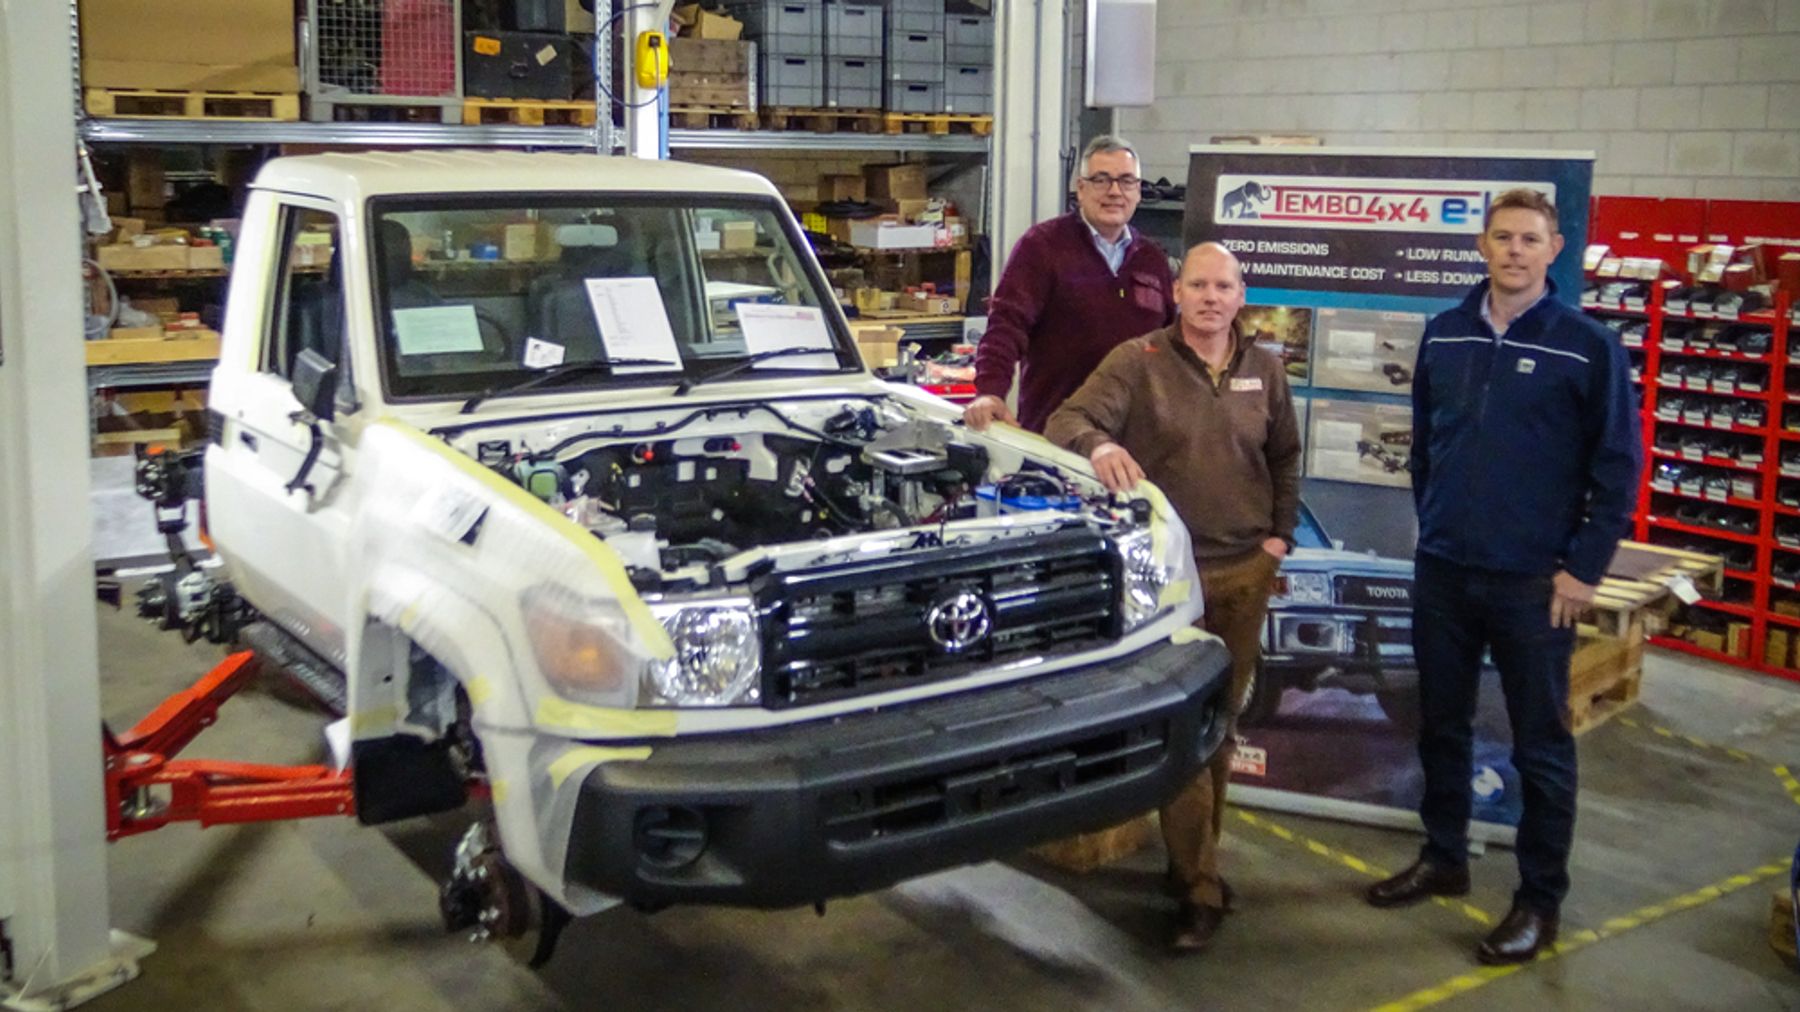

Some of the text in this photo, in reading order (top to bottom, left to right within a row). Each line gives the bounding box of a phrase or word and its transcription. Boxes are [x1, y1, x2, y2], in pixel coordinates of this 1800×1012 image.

[1222, 239, 1329, 256] ZERO EMISSIONS
[1406, 248, 1488, 262] LOW RUNN
[1252, 263, 1348, 279] MAINTENANCE
[1351, 267, 1386, 280] COST
[1406, 270, 1489, 286] LESS DOWN
[1366, 586, 1409, 599] TOYOTA
